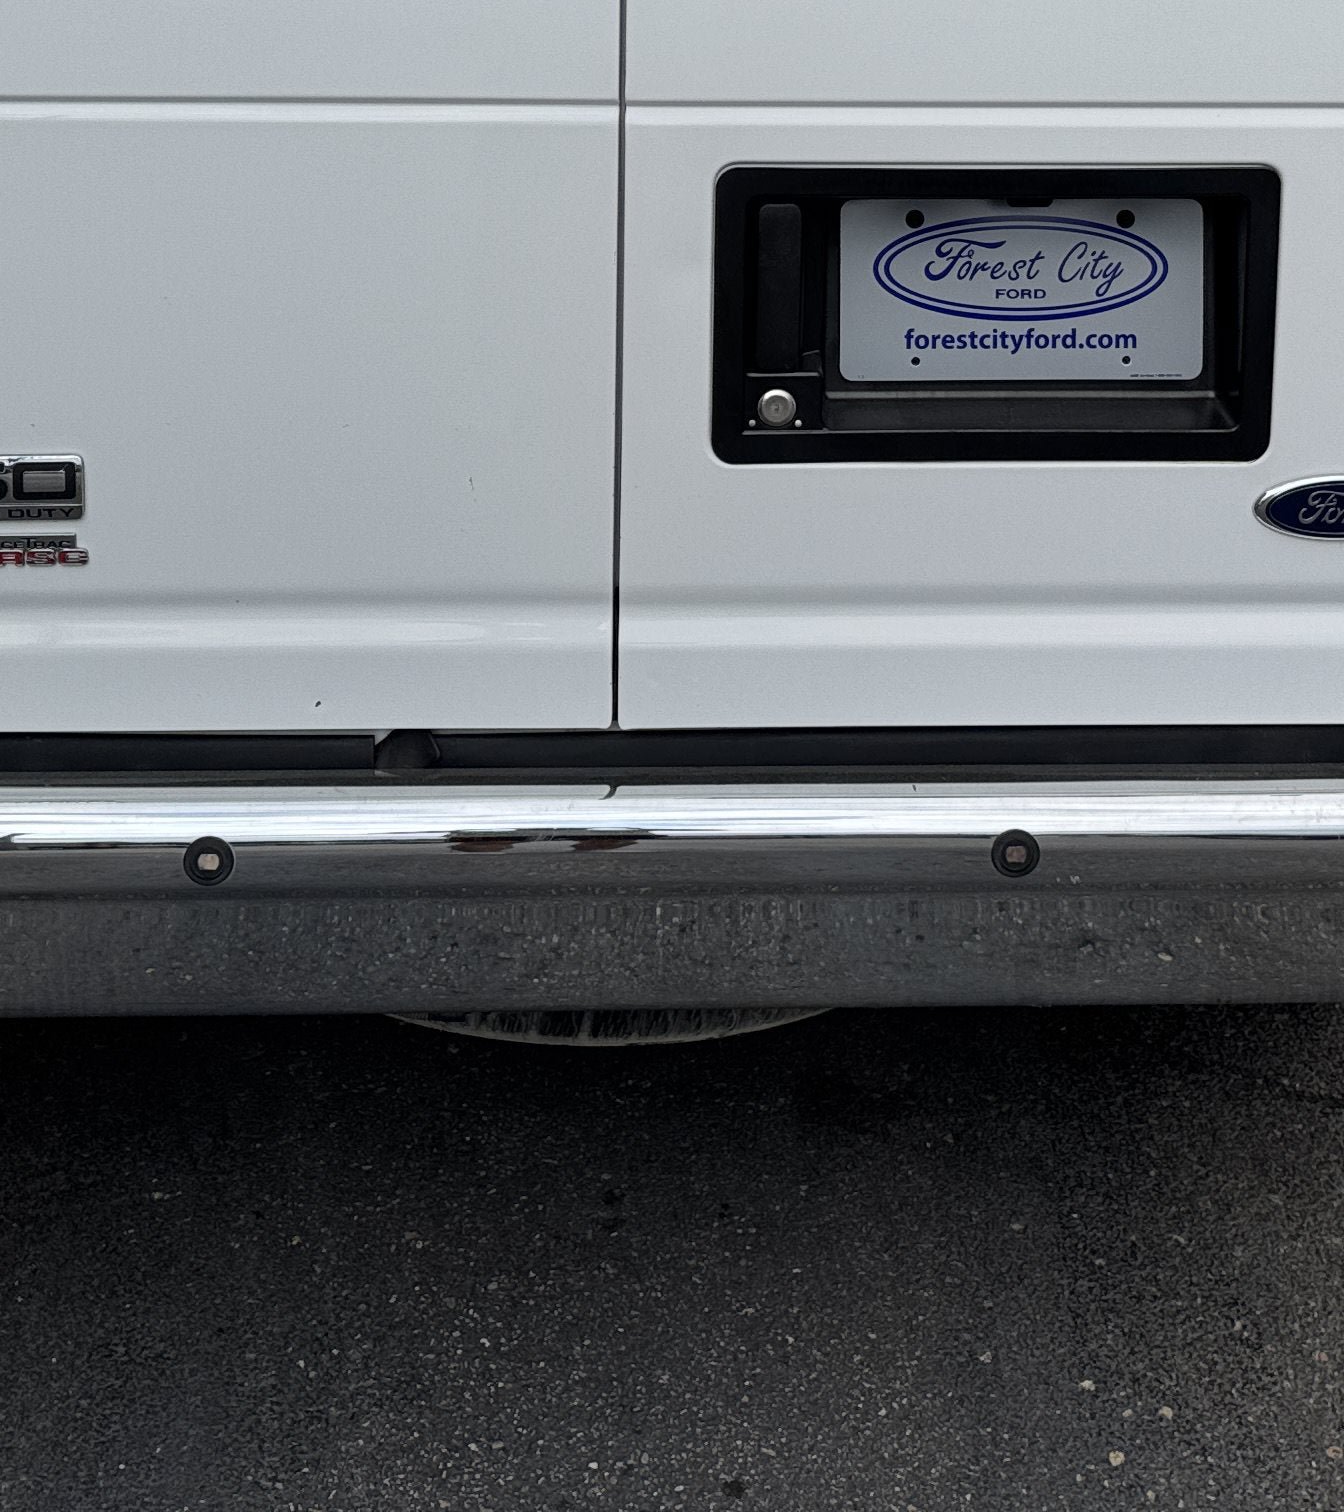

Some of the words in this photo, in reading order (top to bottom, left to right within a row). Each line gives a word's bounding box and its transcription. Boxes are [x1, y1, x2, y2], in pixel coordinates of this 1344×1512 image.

[923, 238, 1046, 281] Forest
[1057, 241, 1124, 297] City
[995, 288, 1047, 300] FORD
[904, 328, 1137, 354] forestcityford.com
[6, 507, 75, 520] DUTY
